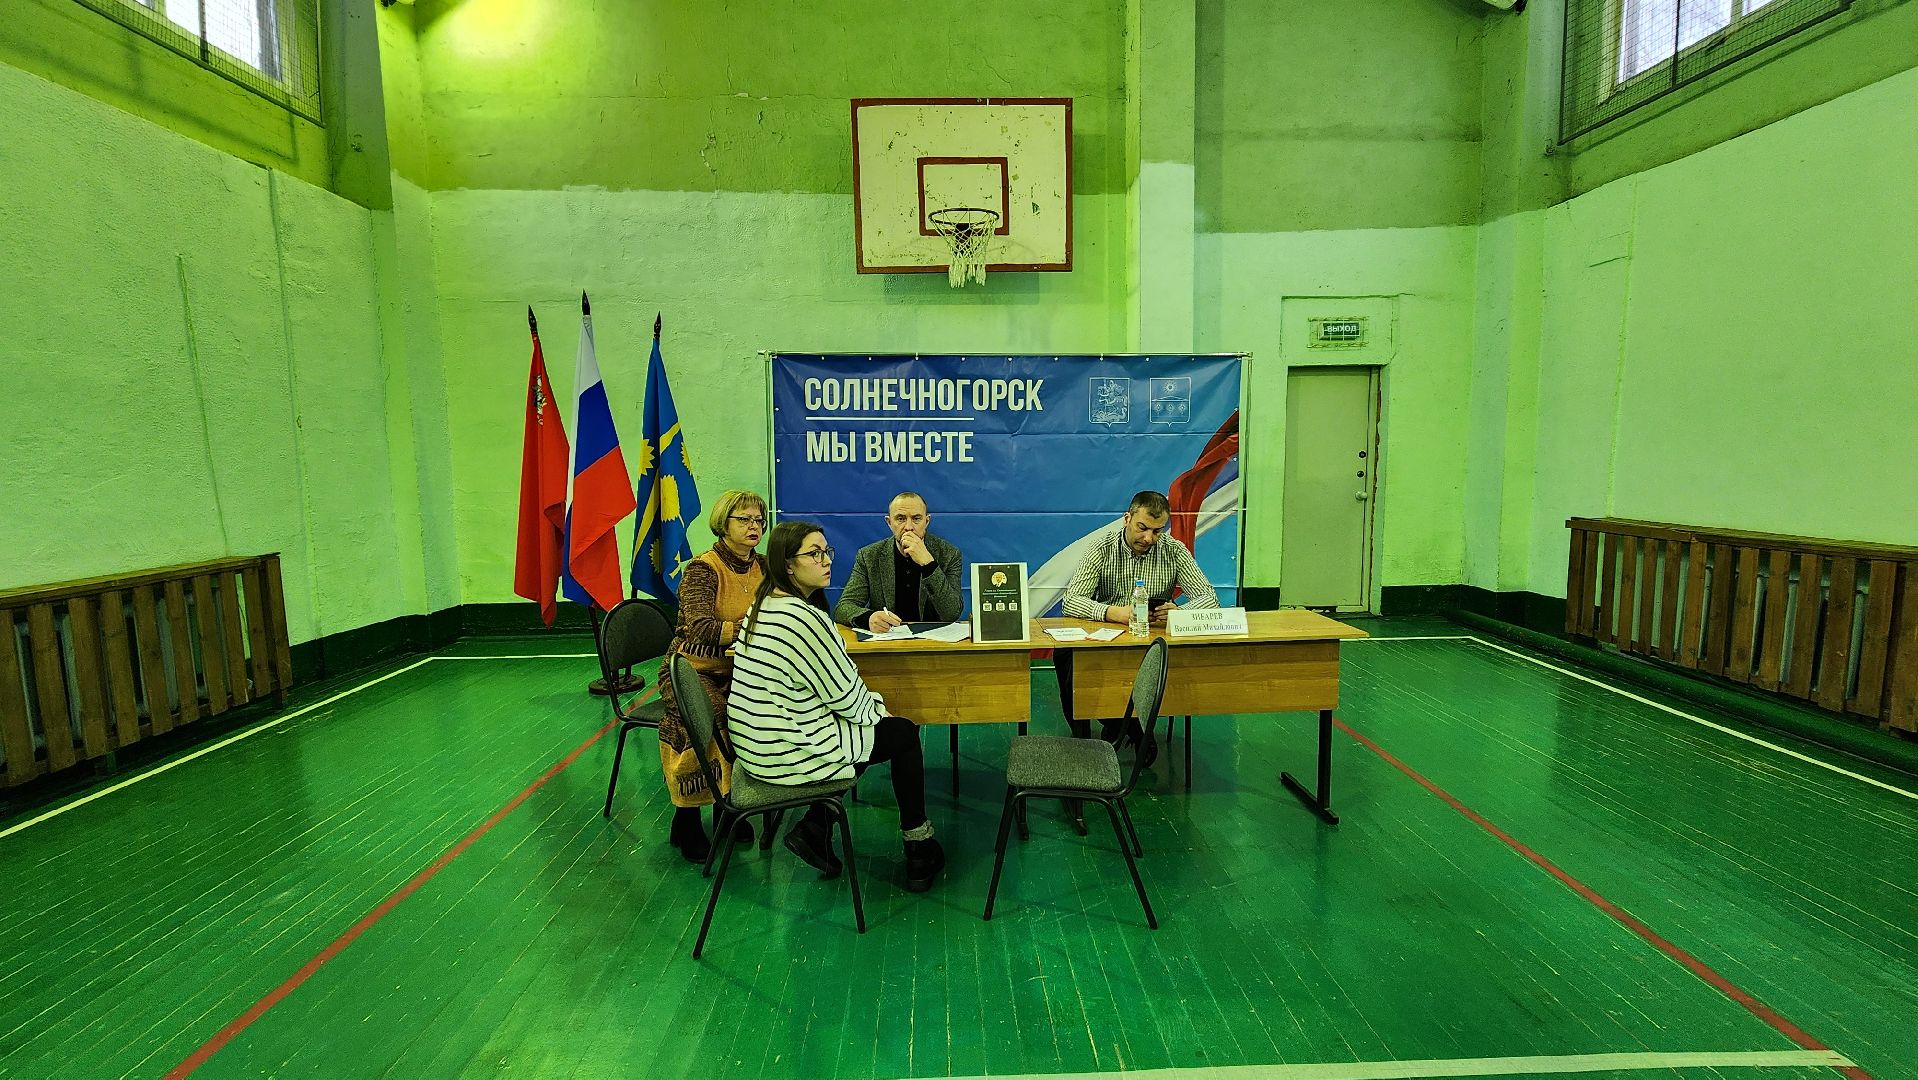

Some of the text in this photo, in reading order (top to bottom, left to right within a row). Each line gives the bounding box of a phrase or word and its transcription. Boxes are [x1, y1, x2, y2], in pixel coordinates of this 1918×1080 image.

[1327, 325, 1357, 333] ВЫХОД
[804, 377, 1044, 411] СОЛНЕЧНОГОРСК
[806, 431, 974, 462] МЫ ВМЕСТЕ
